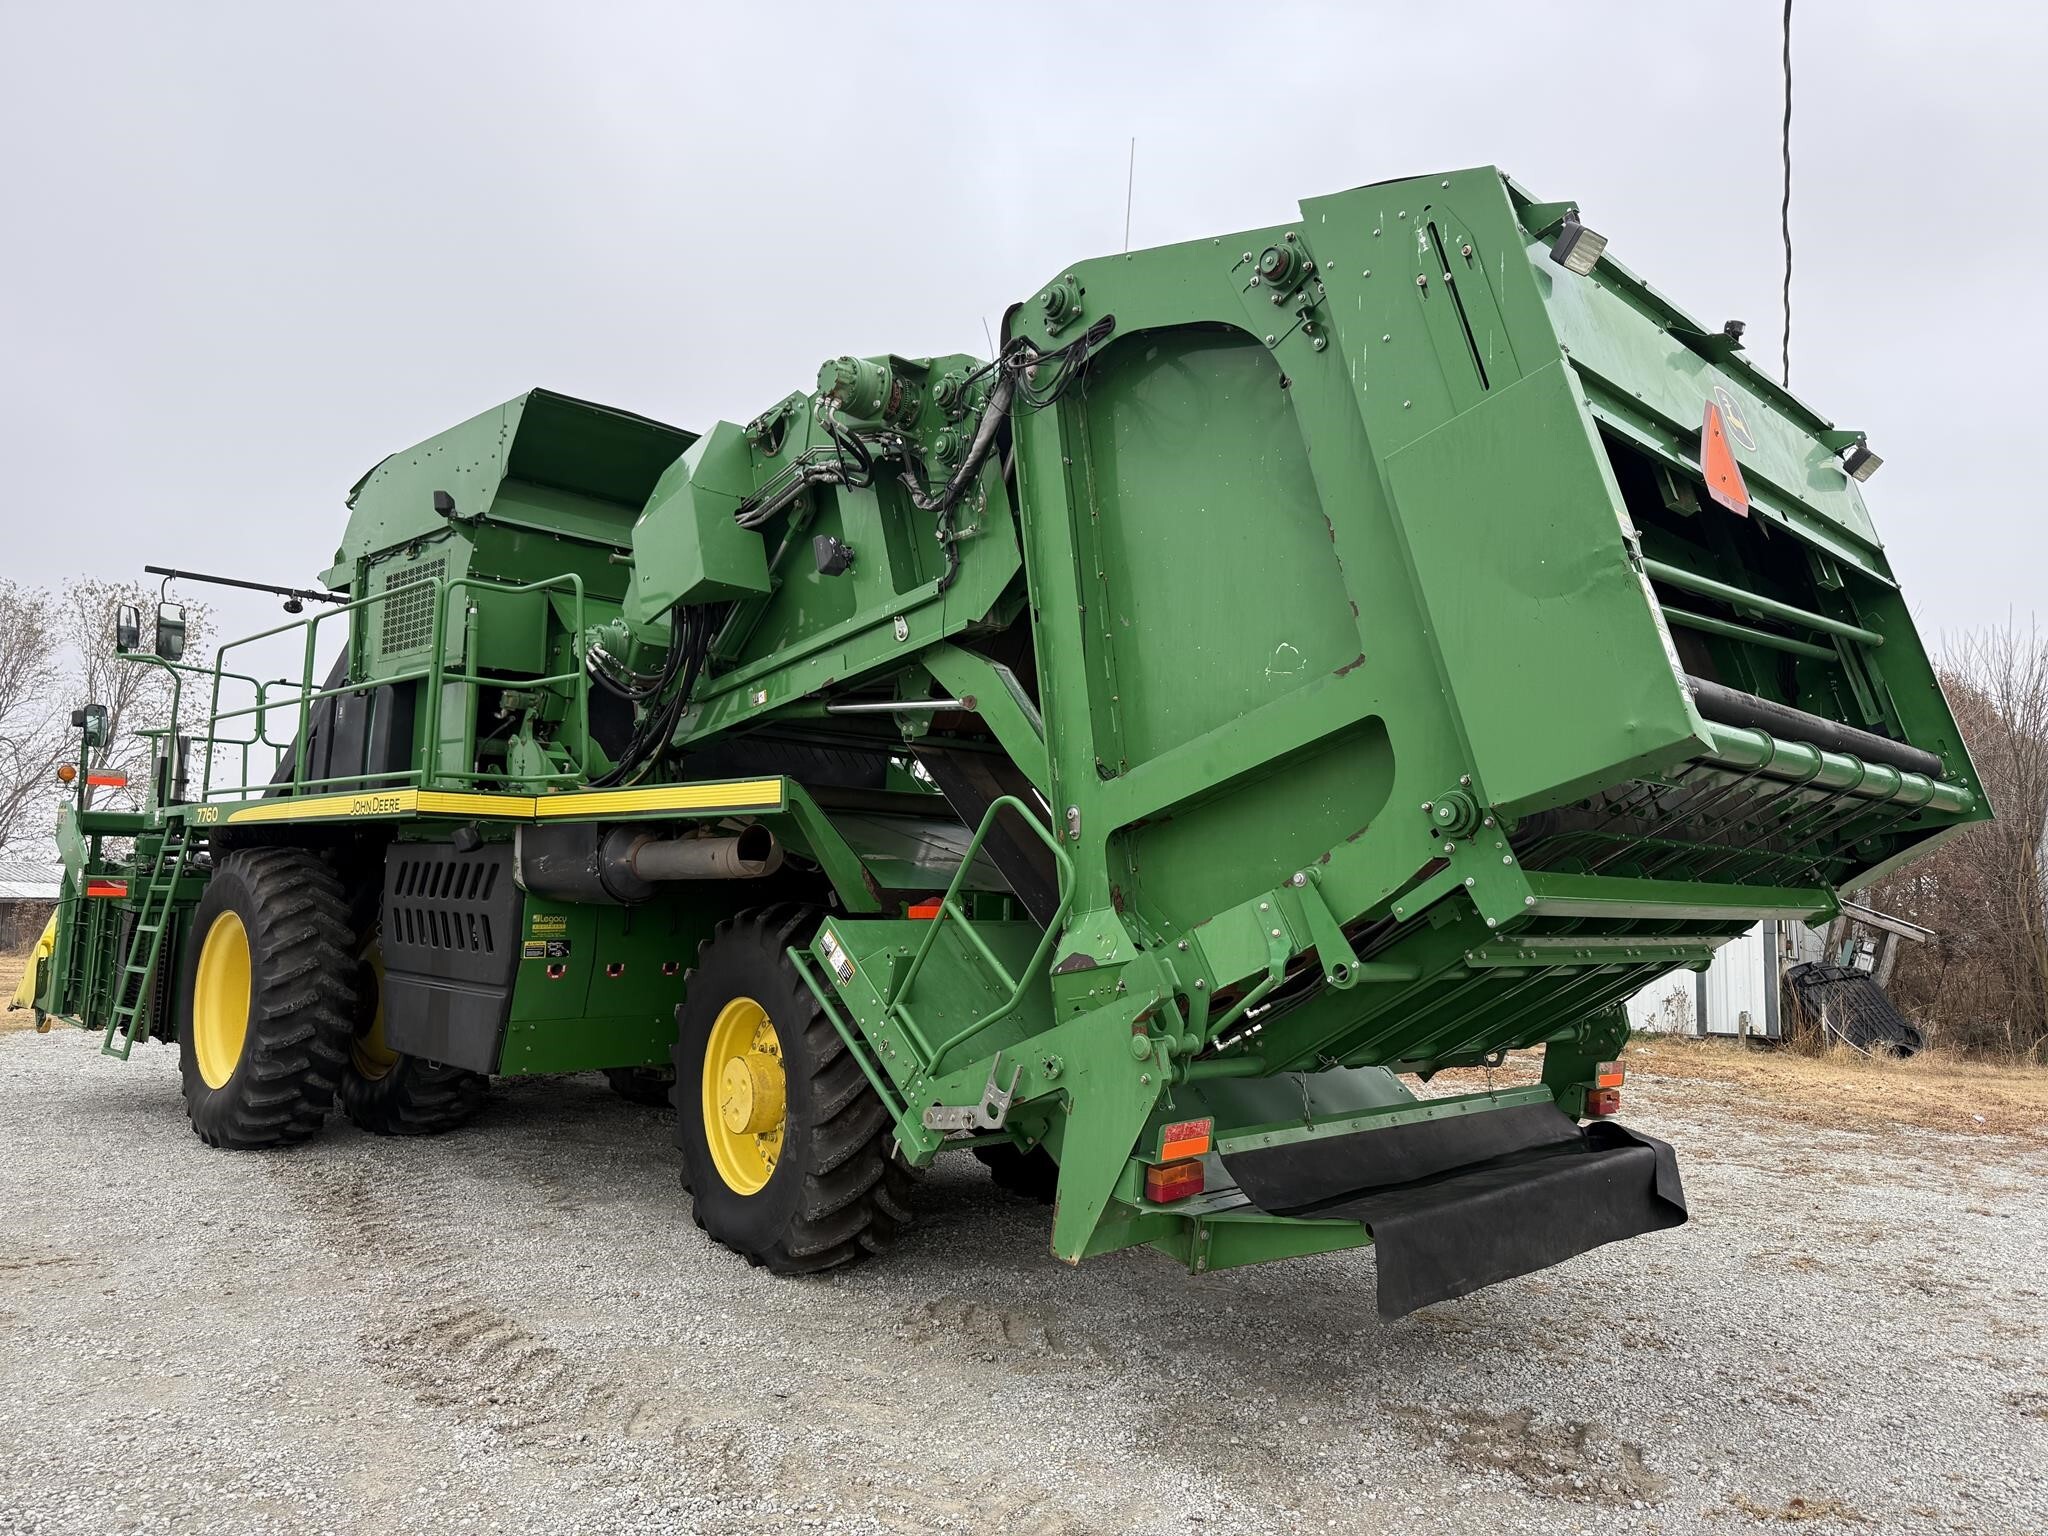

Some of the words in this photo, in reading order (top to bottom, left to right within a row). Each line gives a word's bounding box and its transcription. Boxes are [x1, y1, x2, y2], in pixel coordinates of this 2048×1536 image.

[197, 806, 218, 823] 7760
[350, 798, 371, 816] JOHN
[372, 797, 400, 813] DEERE
[540, 914, 567, 925] Legacy
